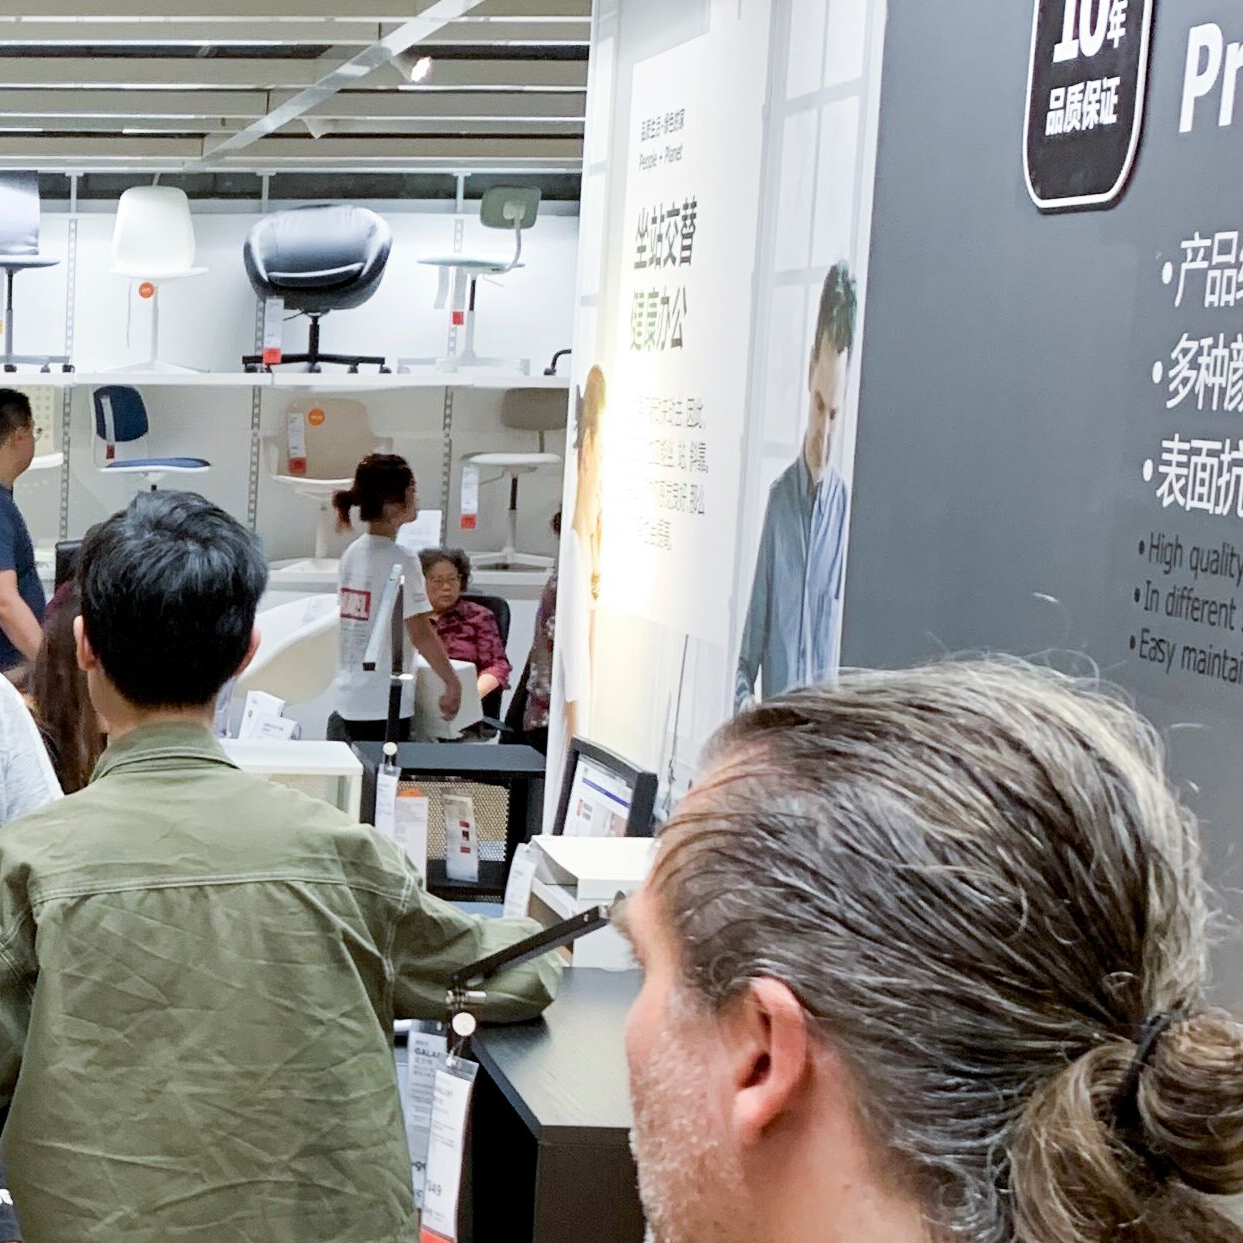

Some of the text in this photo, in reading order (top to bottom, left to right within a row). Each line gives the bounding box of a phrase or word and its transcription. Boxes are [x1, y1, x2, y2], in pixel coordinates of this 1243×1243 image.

[1044, 77, 1120, 136] 品质保证
[634, 195, 697, 269] 坐站交替
[630, 286, 687, 351] 健康办公
[1148, 532, 1243, 587] High quality
[1144, 580, 1236, 631] In different
[1139, 627, 1176, 674] Easy
